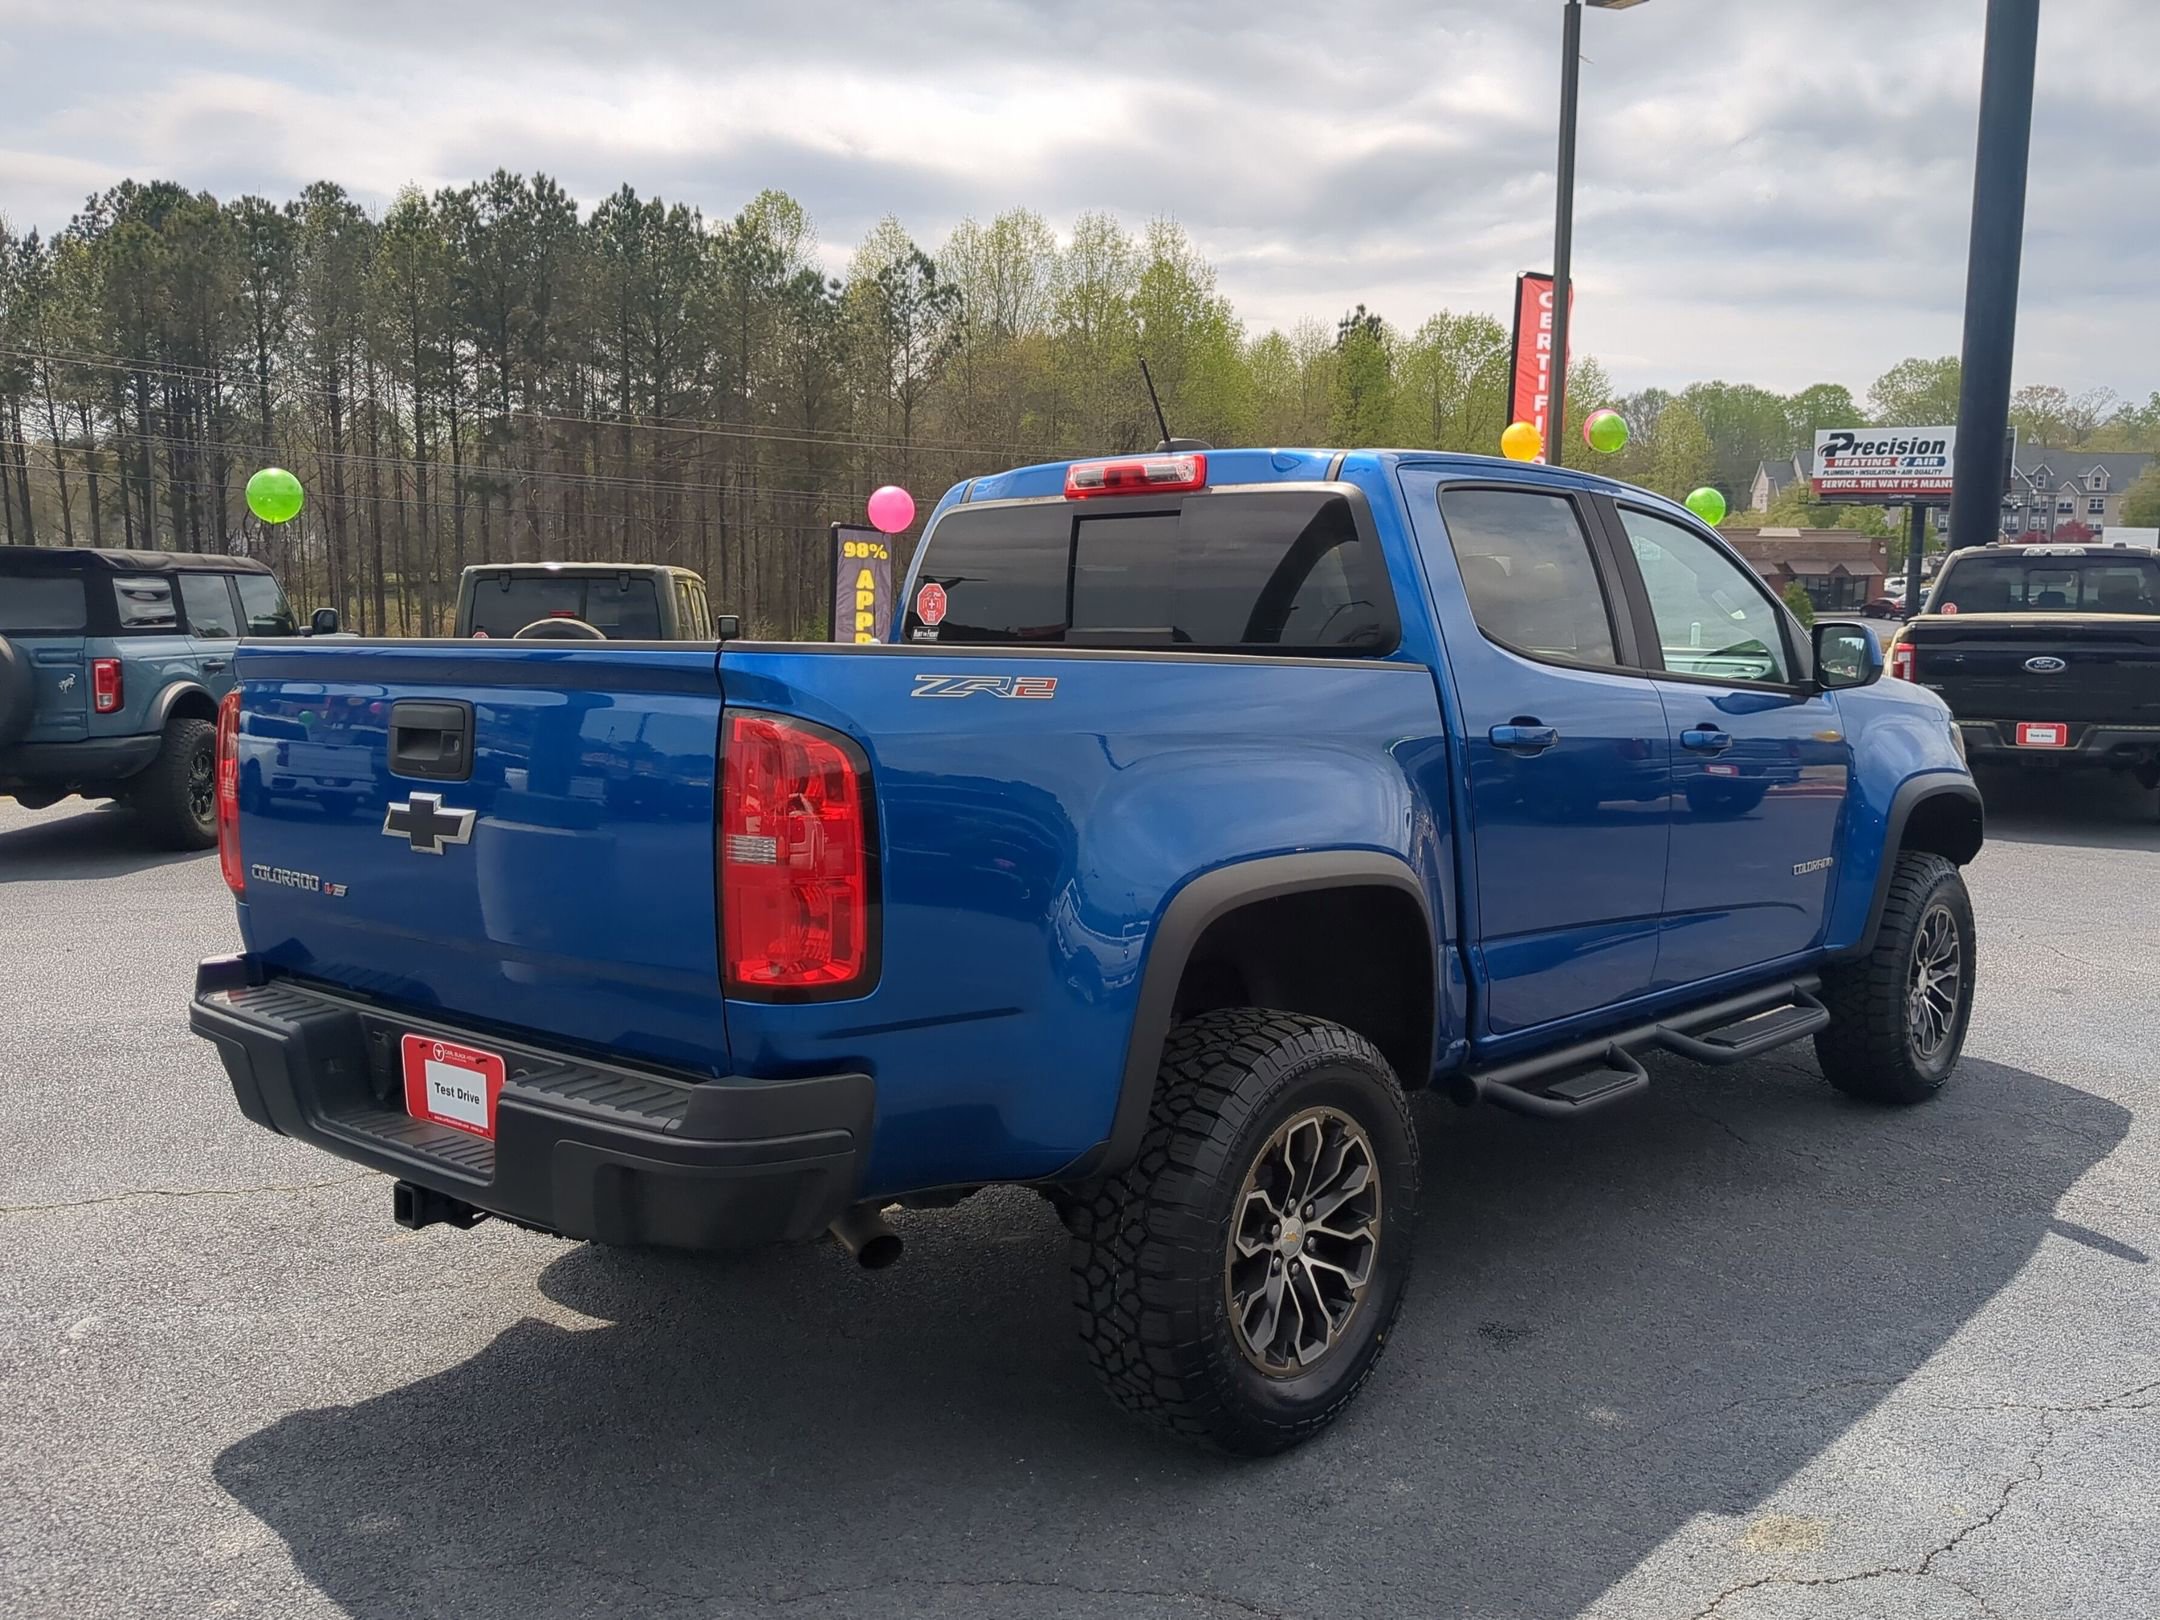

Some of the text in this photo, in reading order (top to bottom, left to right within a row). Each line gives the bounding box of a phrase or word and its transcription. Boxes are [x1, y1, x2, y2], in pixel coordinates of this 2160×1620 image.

[1821, 432, 1946, 457] Precision
[1834, 458, 1891, 467] HEATING
[1914, 457, 1938, 466] AIR
[1821, 479, 1953, 489] SERVICE. THE WAY IT'S MEANT
[843, 541, 888, 560] 98%
[910, 674, 1058, 699] ZR2
[1793, 856, 1833, 876] COLORADO
[251, 863, 320, 892] COLORADO
[434, 1082, 480, 1105] Test Drive
